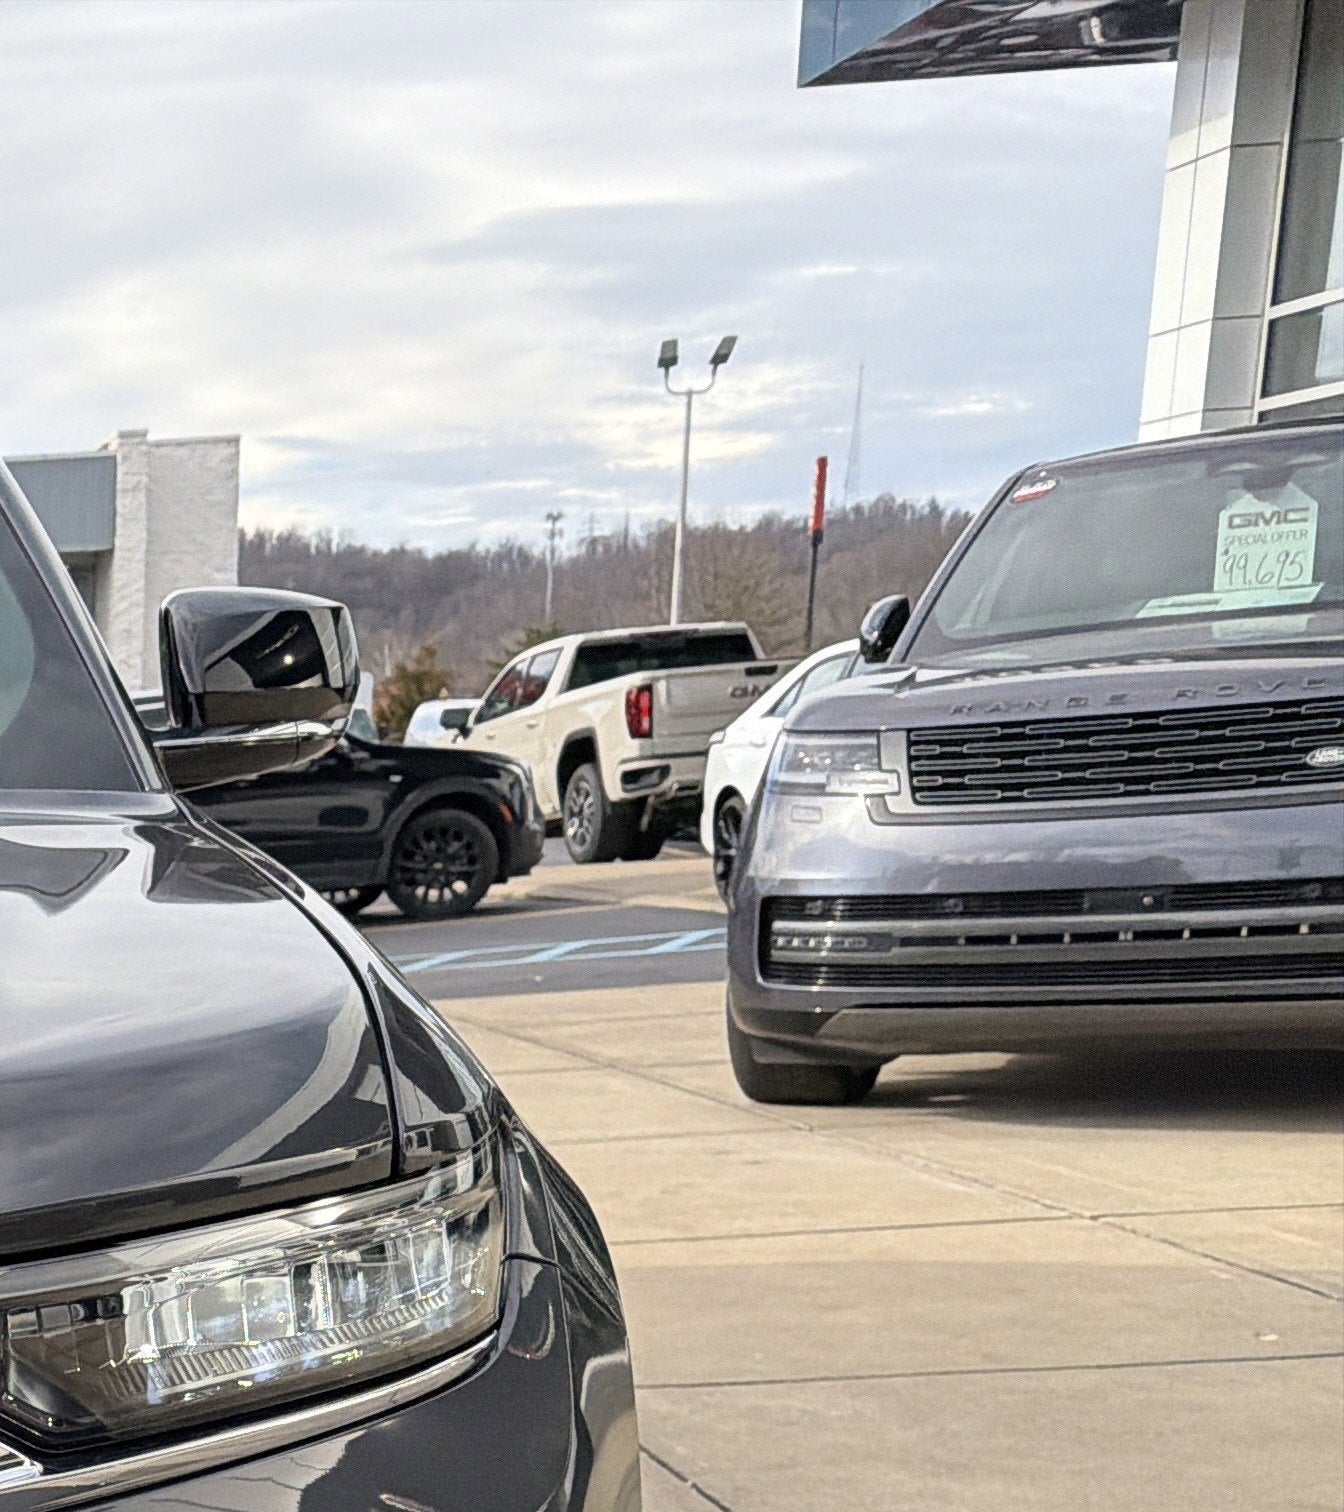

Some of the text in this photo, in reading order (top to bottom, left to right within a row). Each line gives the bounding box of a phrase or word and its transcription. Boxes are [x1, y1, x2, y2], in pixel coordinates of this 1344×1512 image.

[1228, 507, 1310, 529] GMC
[1271, 529, 1308, 541] OFFER
[730, 683, 771, 698] GM
[951, 678, 1327, 715] RANGE ROVE
